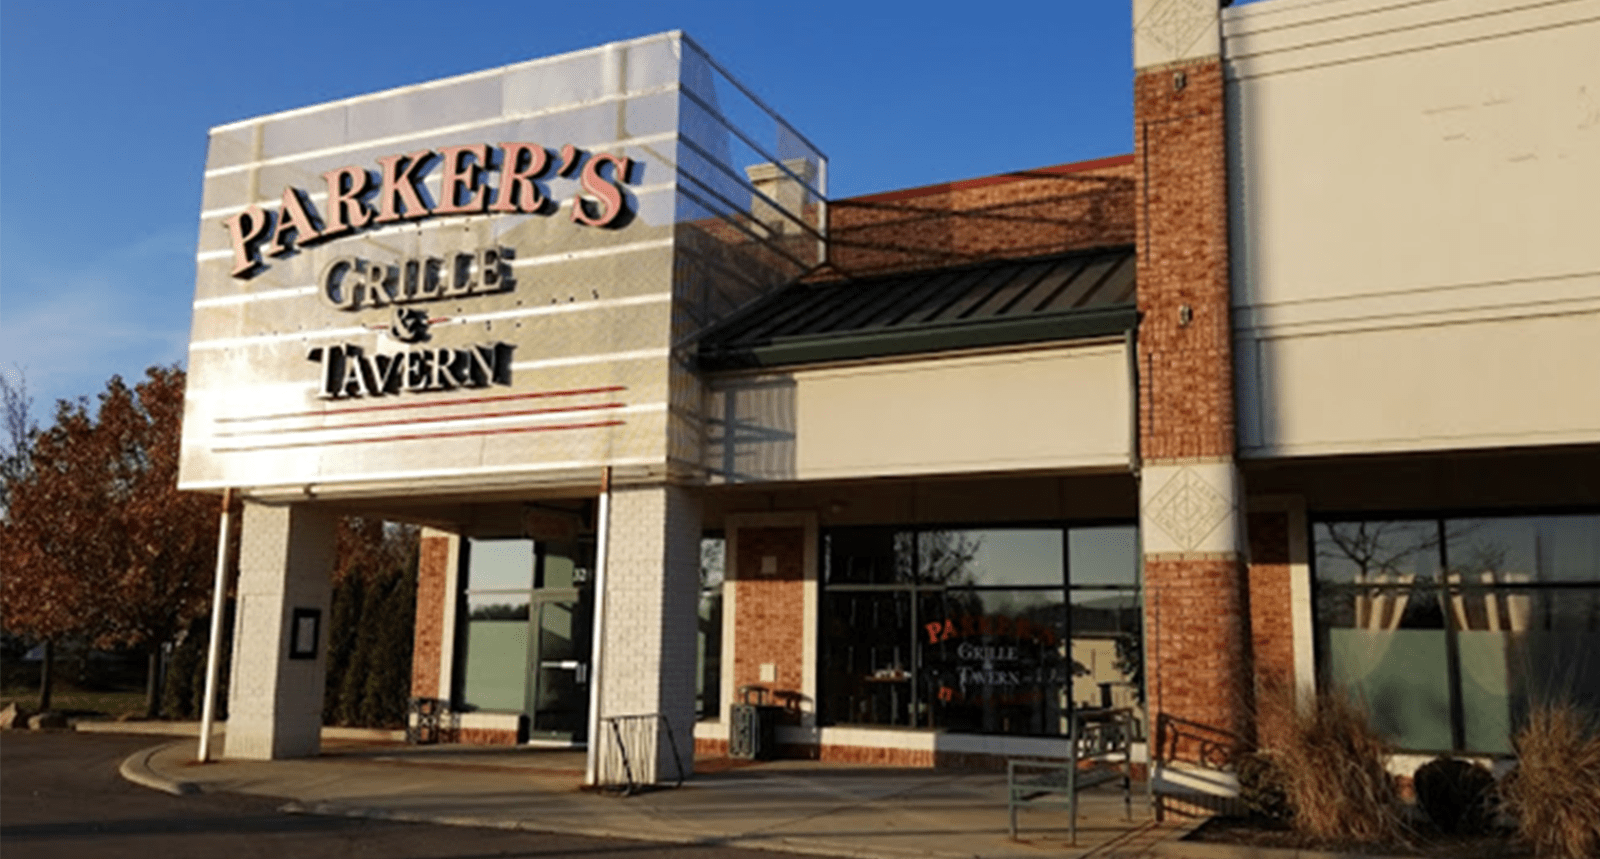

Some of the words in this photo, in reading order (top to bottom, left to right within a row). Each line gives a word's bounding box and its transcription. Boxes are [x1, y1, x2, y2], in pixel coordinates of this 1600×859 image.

[224, 141, 639, 278] PARKER'S
[318, 245, 514, 311] GRILLE
[391, 308, 429, 342] &
[307, 342, 516, 399] TAVERN
